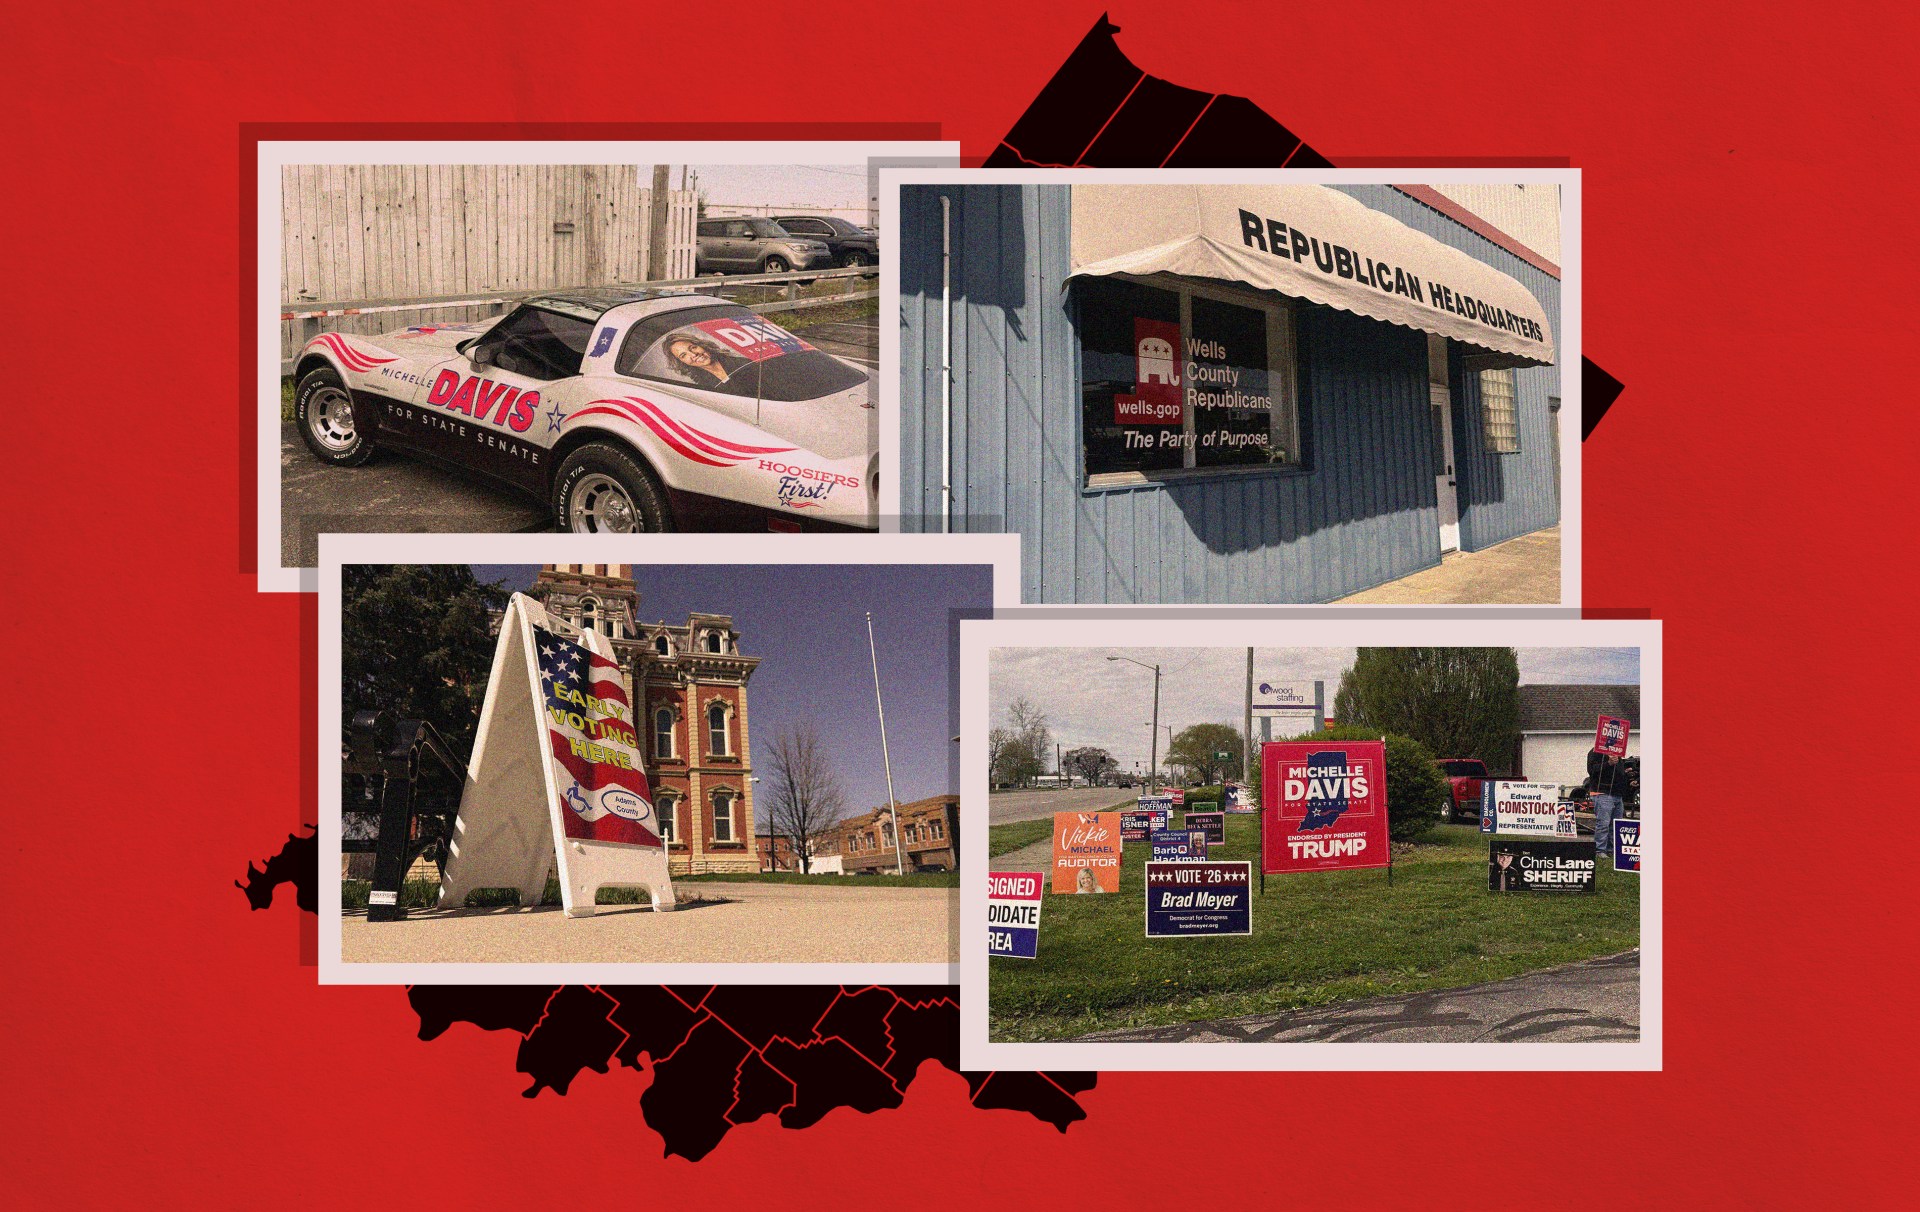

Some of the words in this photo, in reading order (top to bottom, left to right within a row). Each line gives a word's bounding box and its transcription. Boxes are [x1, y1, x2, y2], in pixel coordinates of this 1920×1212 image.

[1238, 208, 1424, 303] REPUBLICAN
[1428, 281, 1544, 343] HEADQUARTERS
[1185, 337, 1227, 360] Wells
[381, 367, 434, 389] MICHELLE
[1186, 361, 1239, 387] County
[299, 387, 312, 419] Radial
[311, 380, 324, 388] T/A
[426, 368, 541, 433] DAVIS
[1186, 387, 1272, 411] Republicans
[1118, 400, 1180, 419] wells.gop
[388, 405, 413, 420] FOR
[422, 414, 466, 437] STATE
[477, 432, 539, 465] SENATE
[1124, 430, 1154, 449] The
[1159, 430, 1197, 450] Party
[1202, 430, 1216, 447] of
[1220, 430, 1268, 448] Purpose
[758, 459, 860, 488] HOOSIERS
[559, 479, 571, 527] Radial
[569, 465, 585, 479] T/A
[778, 476, 835, 500] First!
[553, 681, 625, 721] EARLY
[1276, 693, 1304, 703] staffing
[547, 704, 637, 749] VOTING
[1602, 727, 1625, 740] DAVIS
[569, 737, 633, 771] HERE
[1608, 745, 1623, 753] TRUMP
[1288, 765, 1364, 779] MICHELLE
[1284, 776, 1369, 801] DAVIS
[615, 796, 637, 807] Adams
[616, 805, 639, 817] County
[1498, 801, 1556, 815] COMSTOCK
[1333, 831, 1366, 839] PRESIDENT
[1498, 823, 1553, 831] REPRESENTATIVE
[1619, 826, 1637, 834] GREG
[1061, 826, 1109, 851] Vickie
[1070, 846, 1115, 854] MICHAEL
[1153, 846, 1178, 855] Barb
[1287, 838, 1367, 860] TRUMP
[1058, 858, 1117, 868] AUDITOR
[1520, 856, 1555, 869] Chris
[1555, 856, 1595, 869] Lane
[1175, 869, 1202, 883] VOTE
[1523, 870, 1593, 883] SHERIFF
[988, 877, 1036, 896] SIGNED
[1161, 891, 1194, 908] Brad
[1195, 891, 1238, 910] Meyer
[988, 904, 1038, 925] DIDATE
[1203, 914, 1228, 922] Congress
[988, 931, 1013, 952] REA
